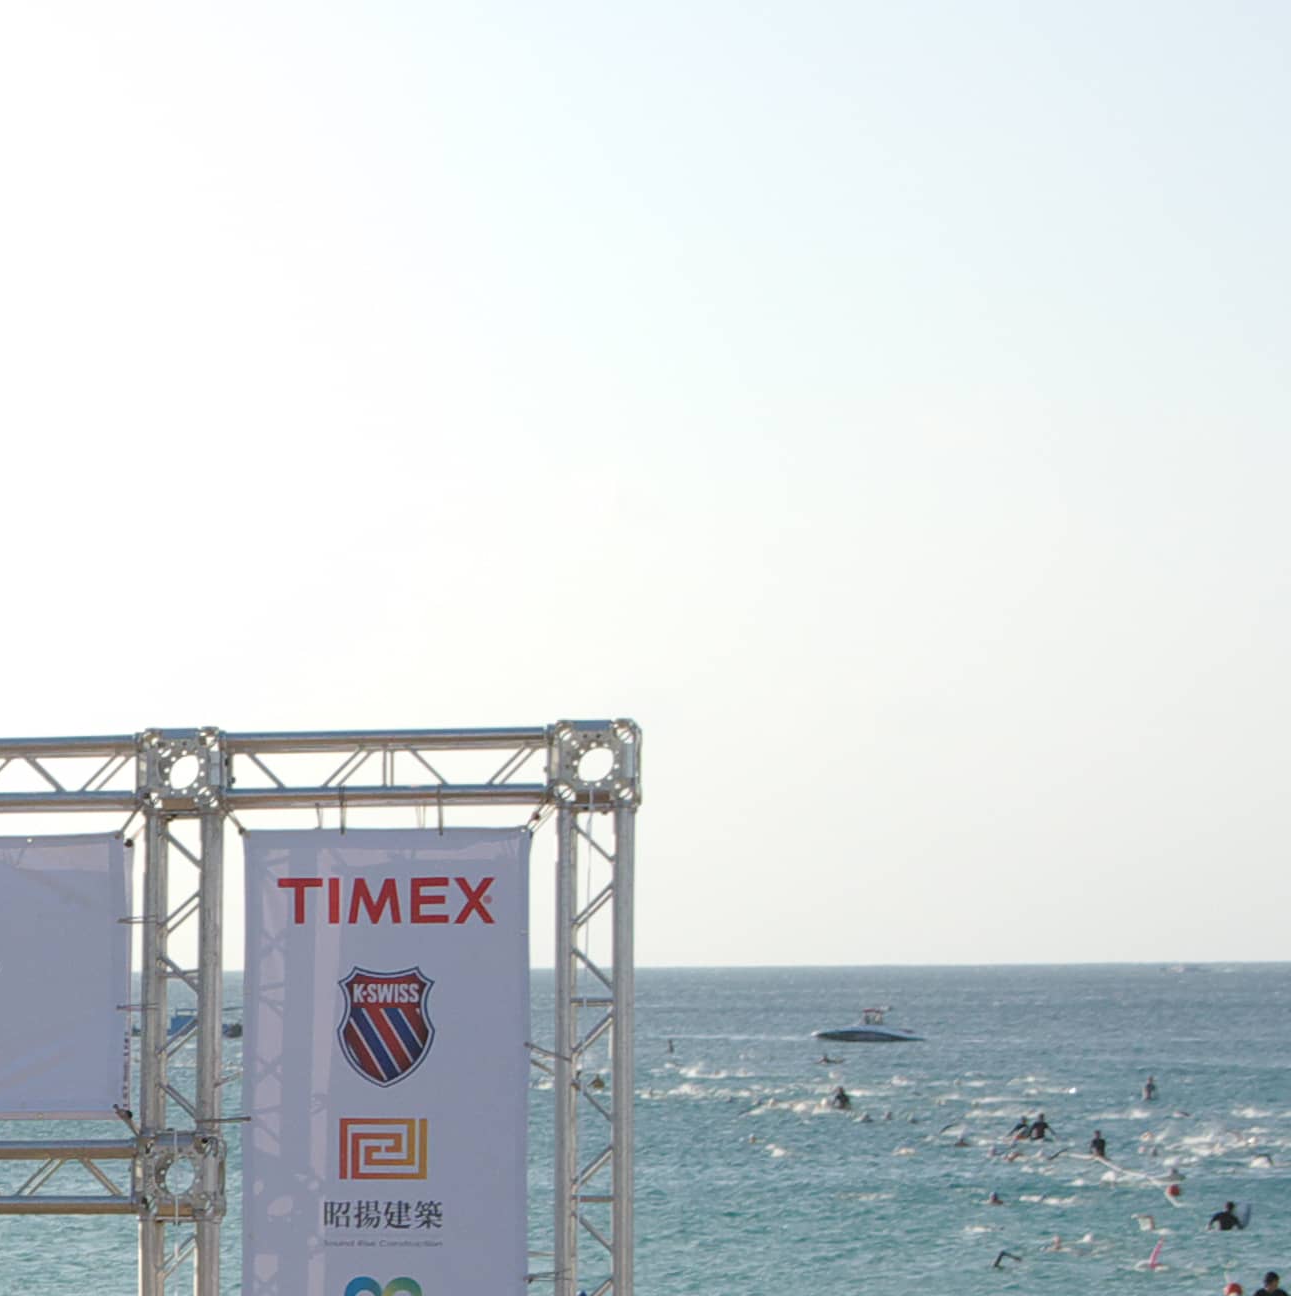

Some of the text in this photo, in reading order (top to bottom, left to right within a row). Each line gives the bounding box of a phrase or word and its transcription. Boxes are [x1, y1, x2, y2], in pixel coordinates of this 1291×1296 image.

[277, 877, 496, 924] TIMEX
[323, 1200, 443, 1229] 昭揚建築
